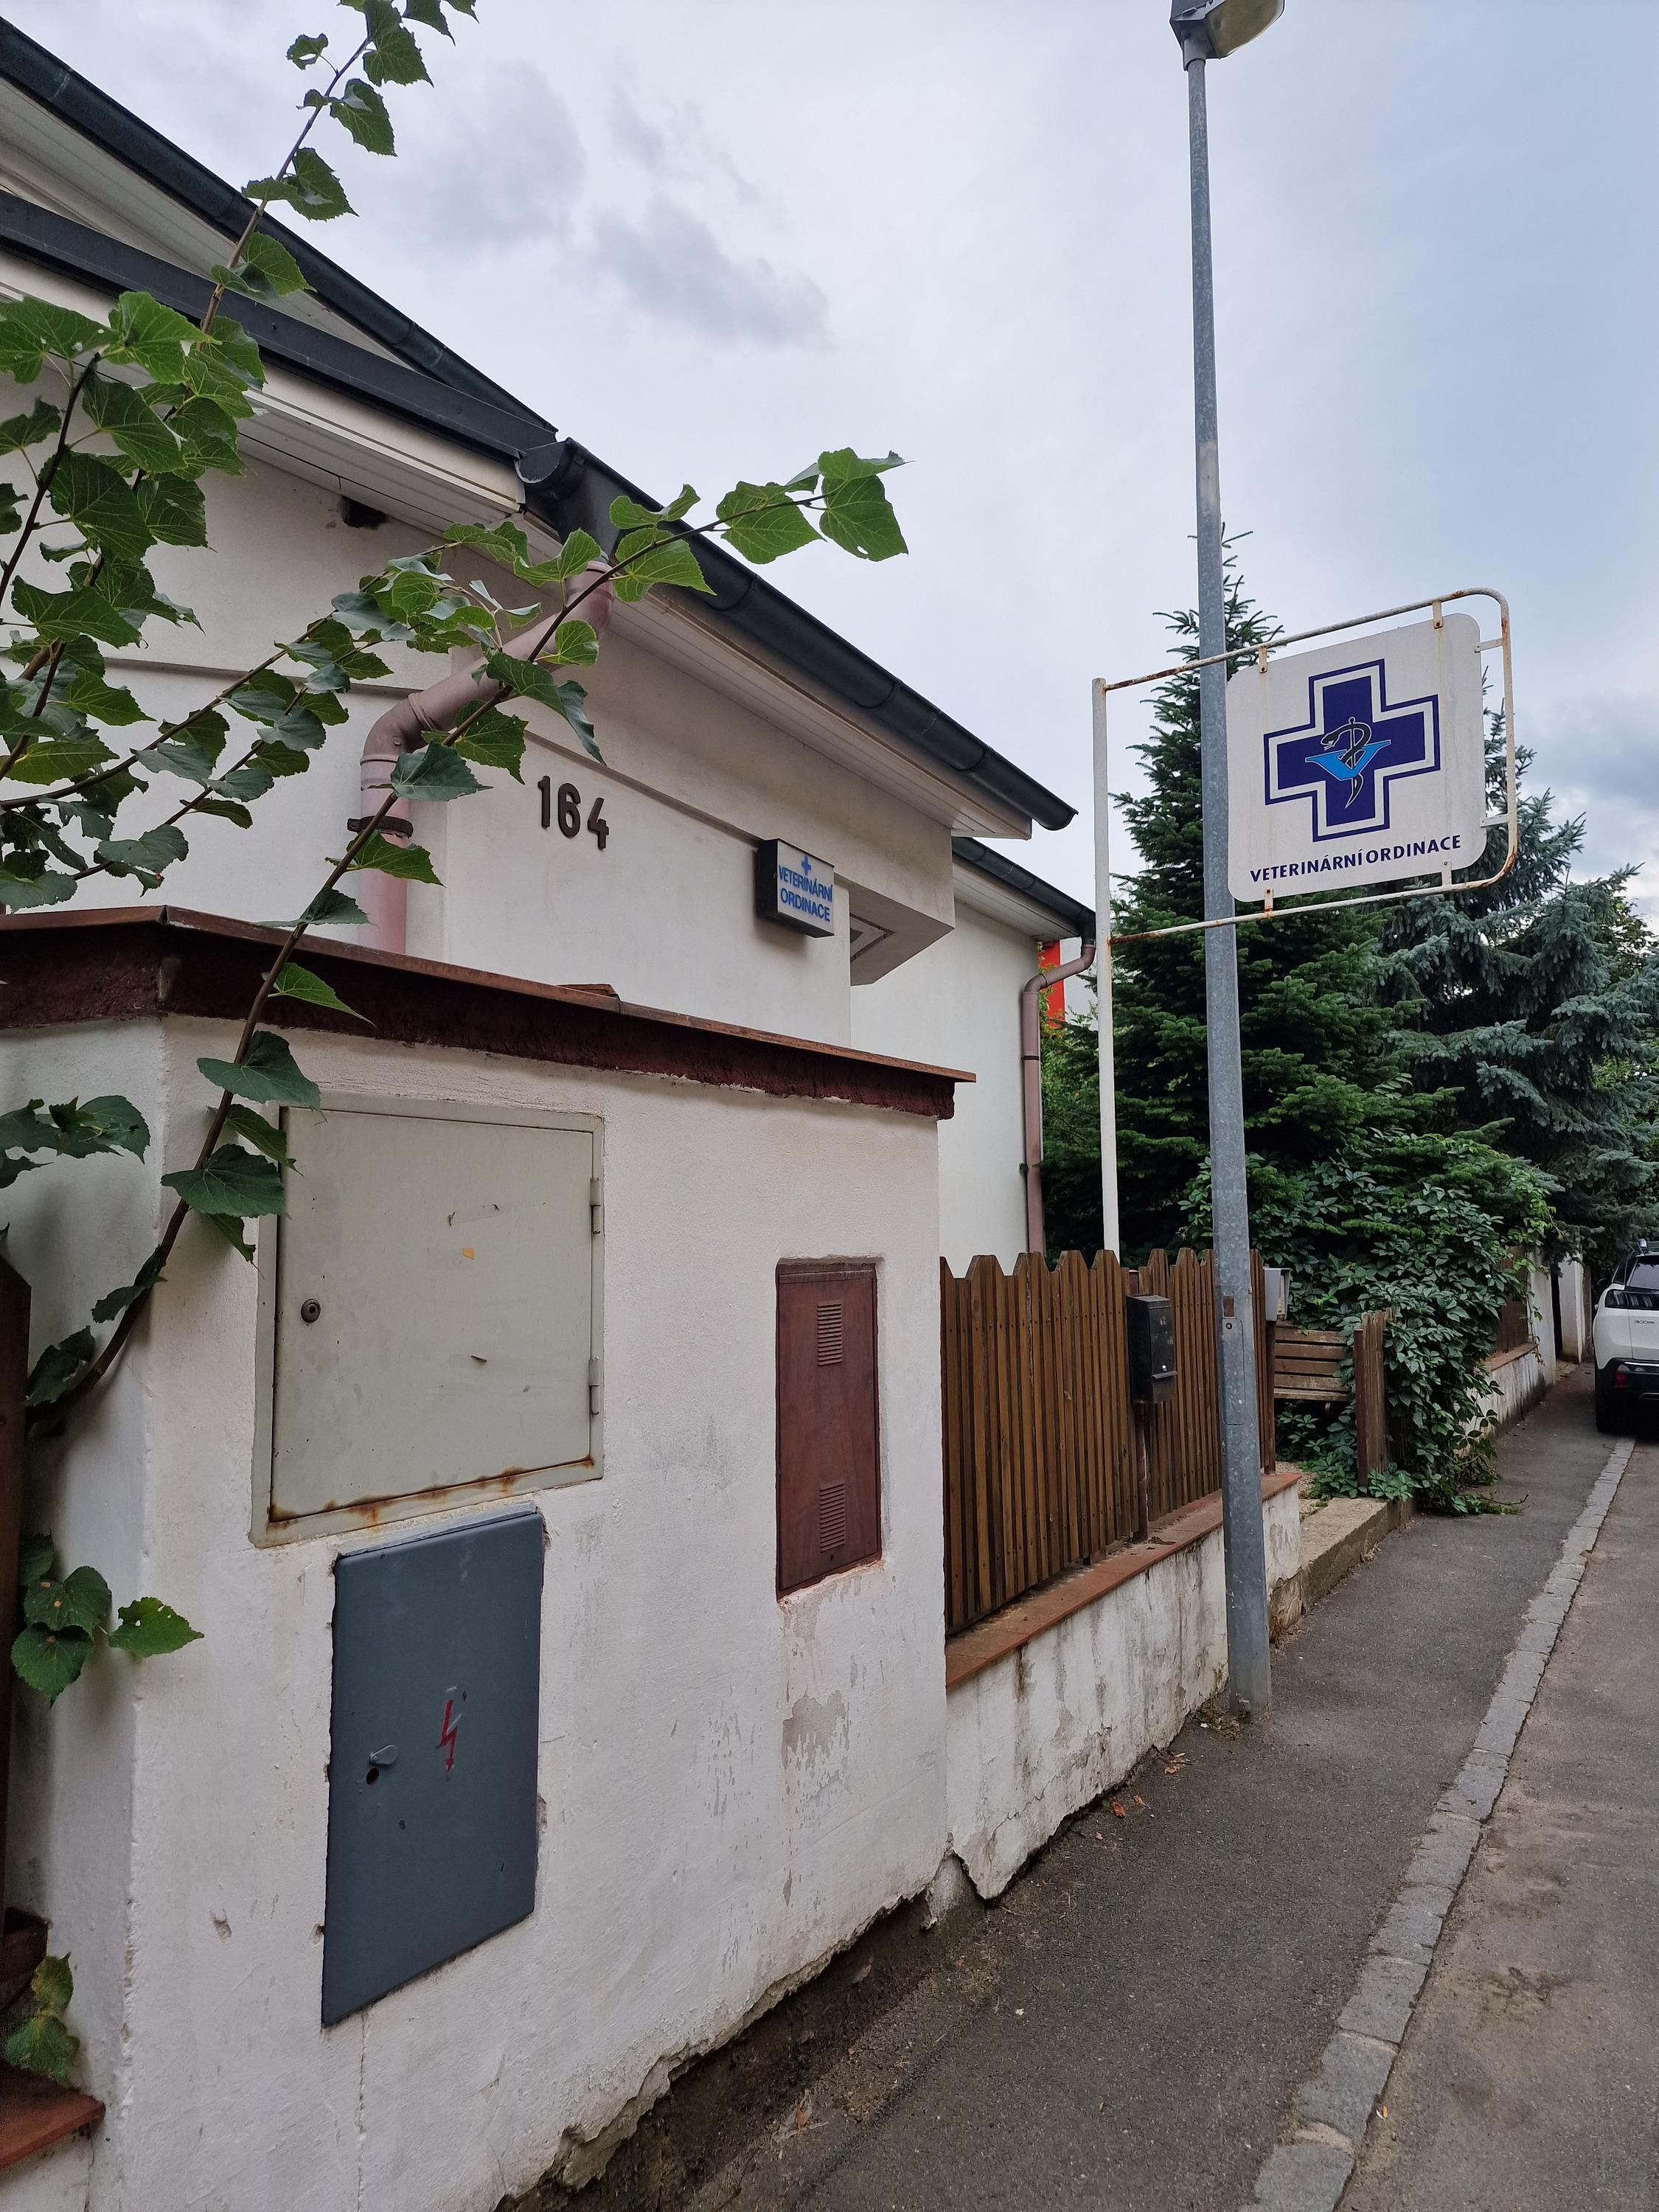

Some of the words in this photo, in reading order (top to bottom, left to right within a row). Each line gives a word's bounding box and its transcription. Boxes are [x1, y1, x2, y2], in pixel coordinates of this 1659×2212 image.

[538, 775, 609, 849] 164
[1250, 849, 1363, 883] VETERINÁRNÍ
[1366, 835, 1461, 863] ORDINACE
[779, 864, 833, 902] VETERINÁRNÍ
[780, 887, 830, 922] ORDINACE
